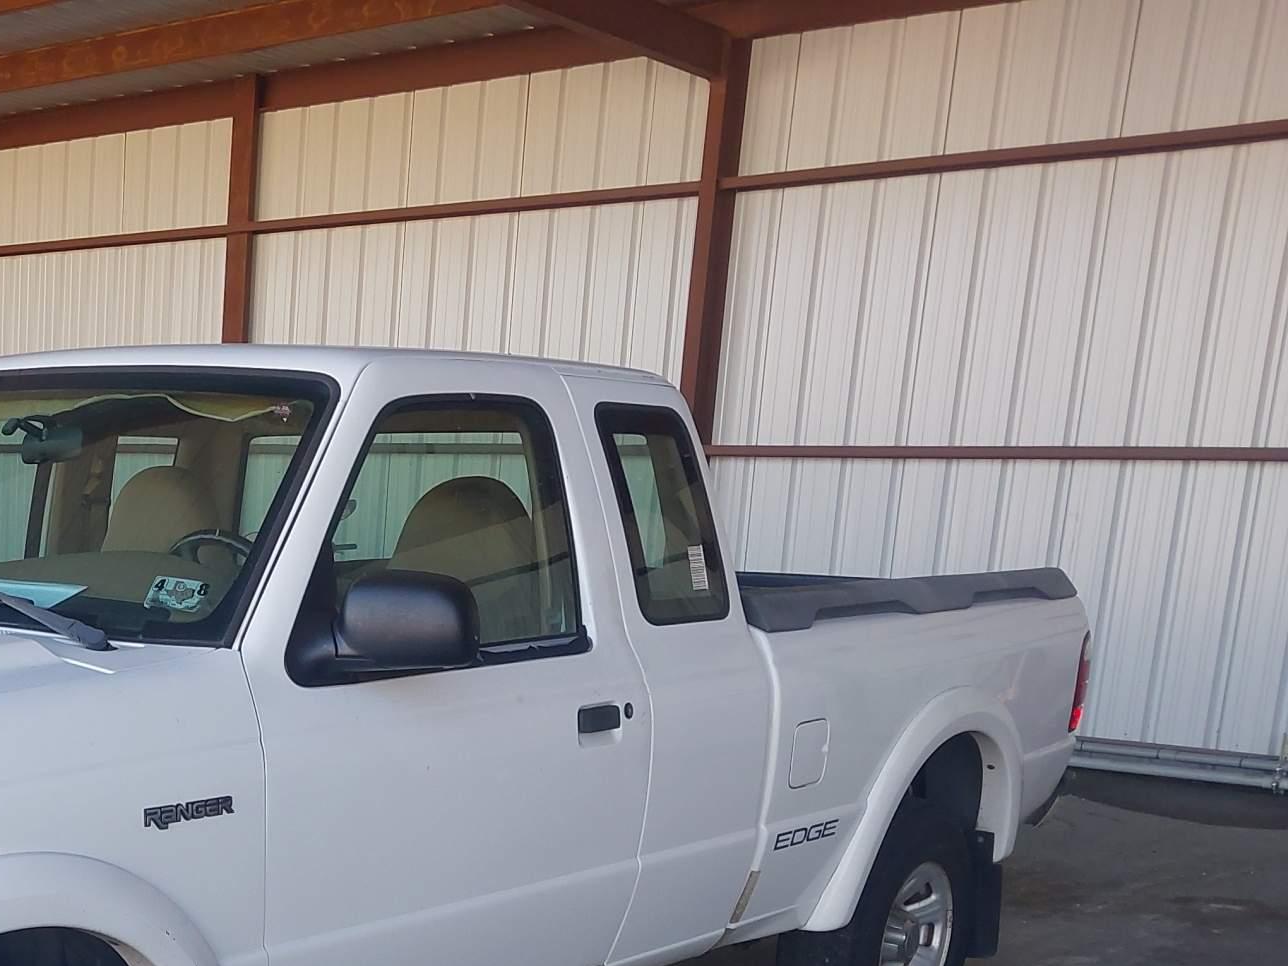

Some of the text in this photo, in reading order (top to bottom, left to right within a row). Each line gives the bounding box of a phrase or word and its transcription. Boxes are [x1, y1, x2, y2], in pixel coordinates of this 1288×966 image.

[153, 579, 210, 596] 4 8
[144, 795, 235, 830] RANGER
[773, 819, 840, 851] EDGE
